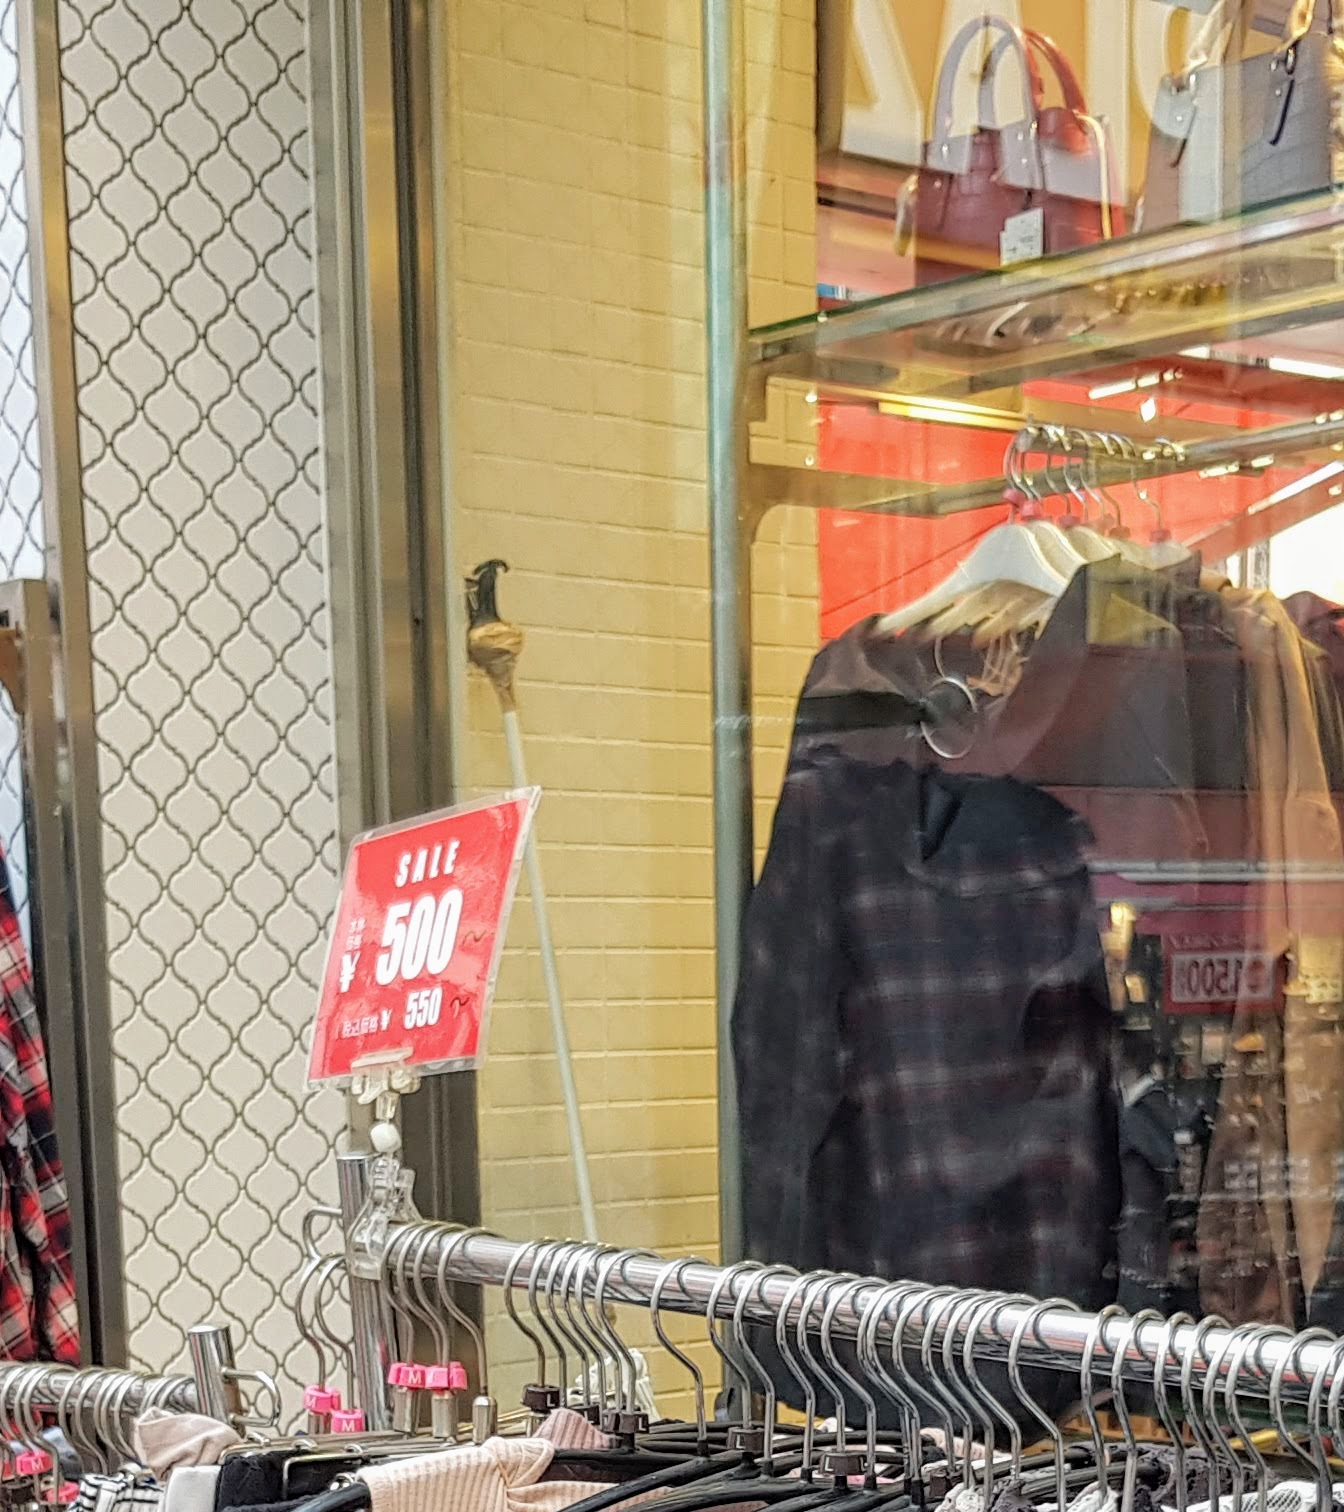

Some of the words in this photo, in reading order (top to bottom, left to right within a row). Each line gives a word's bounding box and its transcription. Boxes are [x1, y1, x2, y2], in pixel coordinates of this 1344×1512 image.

[394, 838, 460, 888] SALE
[404, 986, 443, 1031] 550
[408, 1370, 422, 1384] M
[546, 1393, 556, 1407] L
[342, 1419, 355, 1432] M
[735, 1434, 745, 1449] L
[31, 1457, 44, 1471] M
[824, 1455, 834, 1472] L
